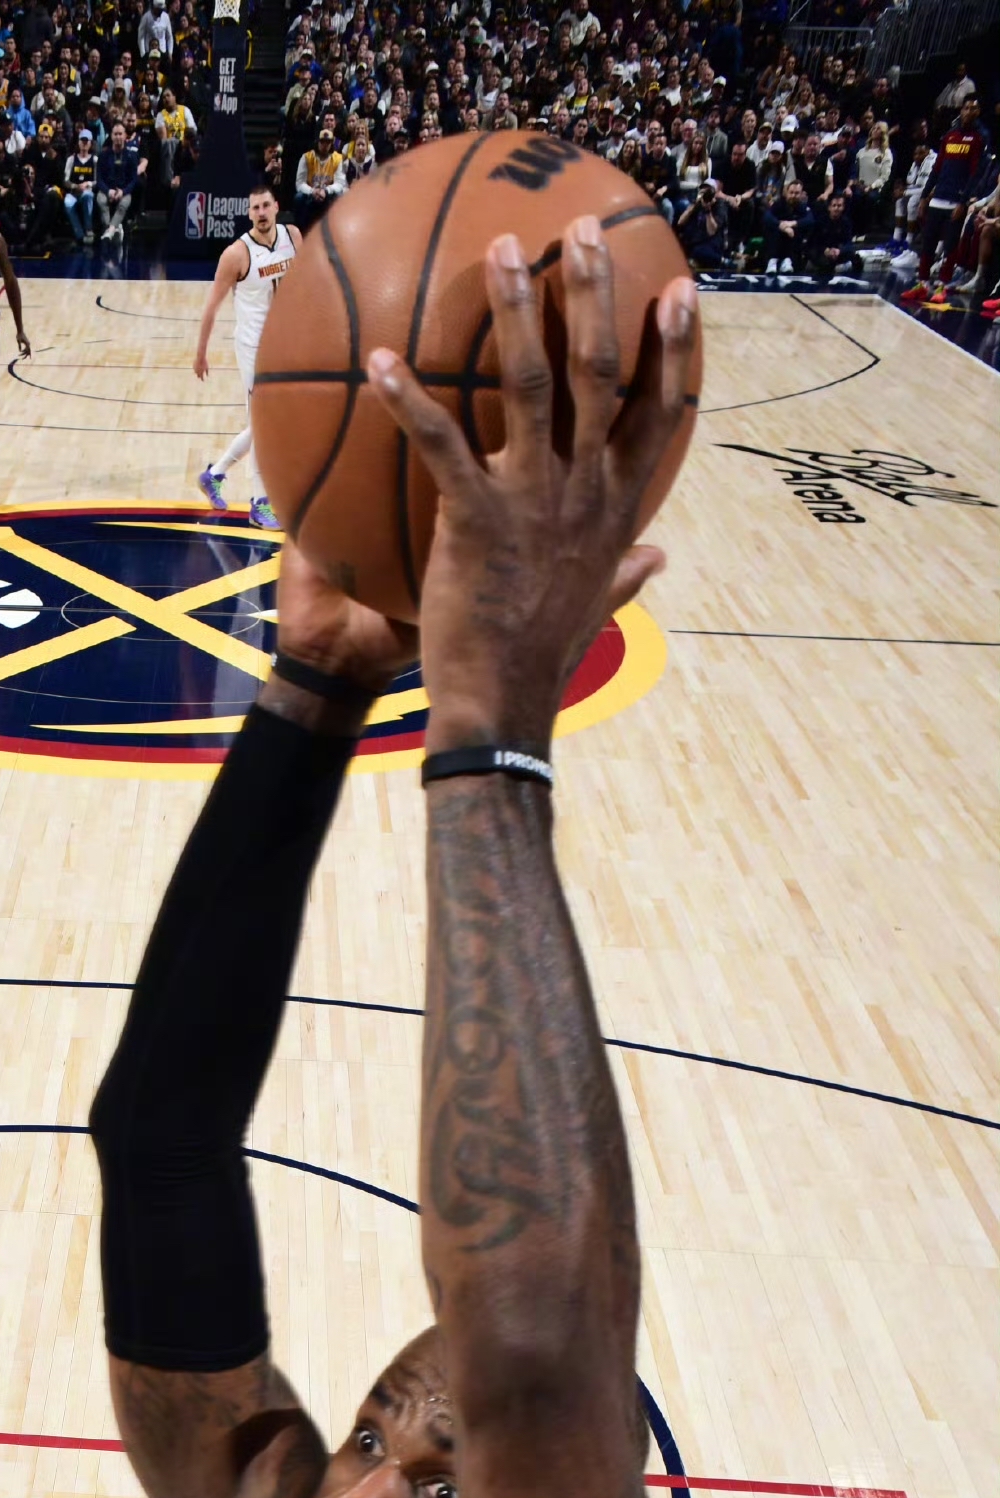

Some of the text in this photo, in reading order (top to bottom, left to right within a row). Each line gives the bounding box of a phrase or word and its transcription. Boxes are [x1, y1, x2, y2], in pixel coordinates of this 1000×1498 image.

[219, 57, 236, 75] GET
[219, 75, 235, 93] THE
[222, 94, 238, 114] App
[208, 193, 250, 220] League
[206, 215, 235, 238] Pass
[772, 467, 867, 524] Arena
